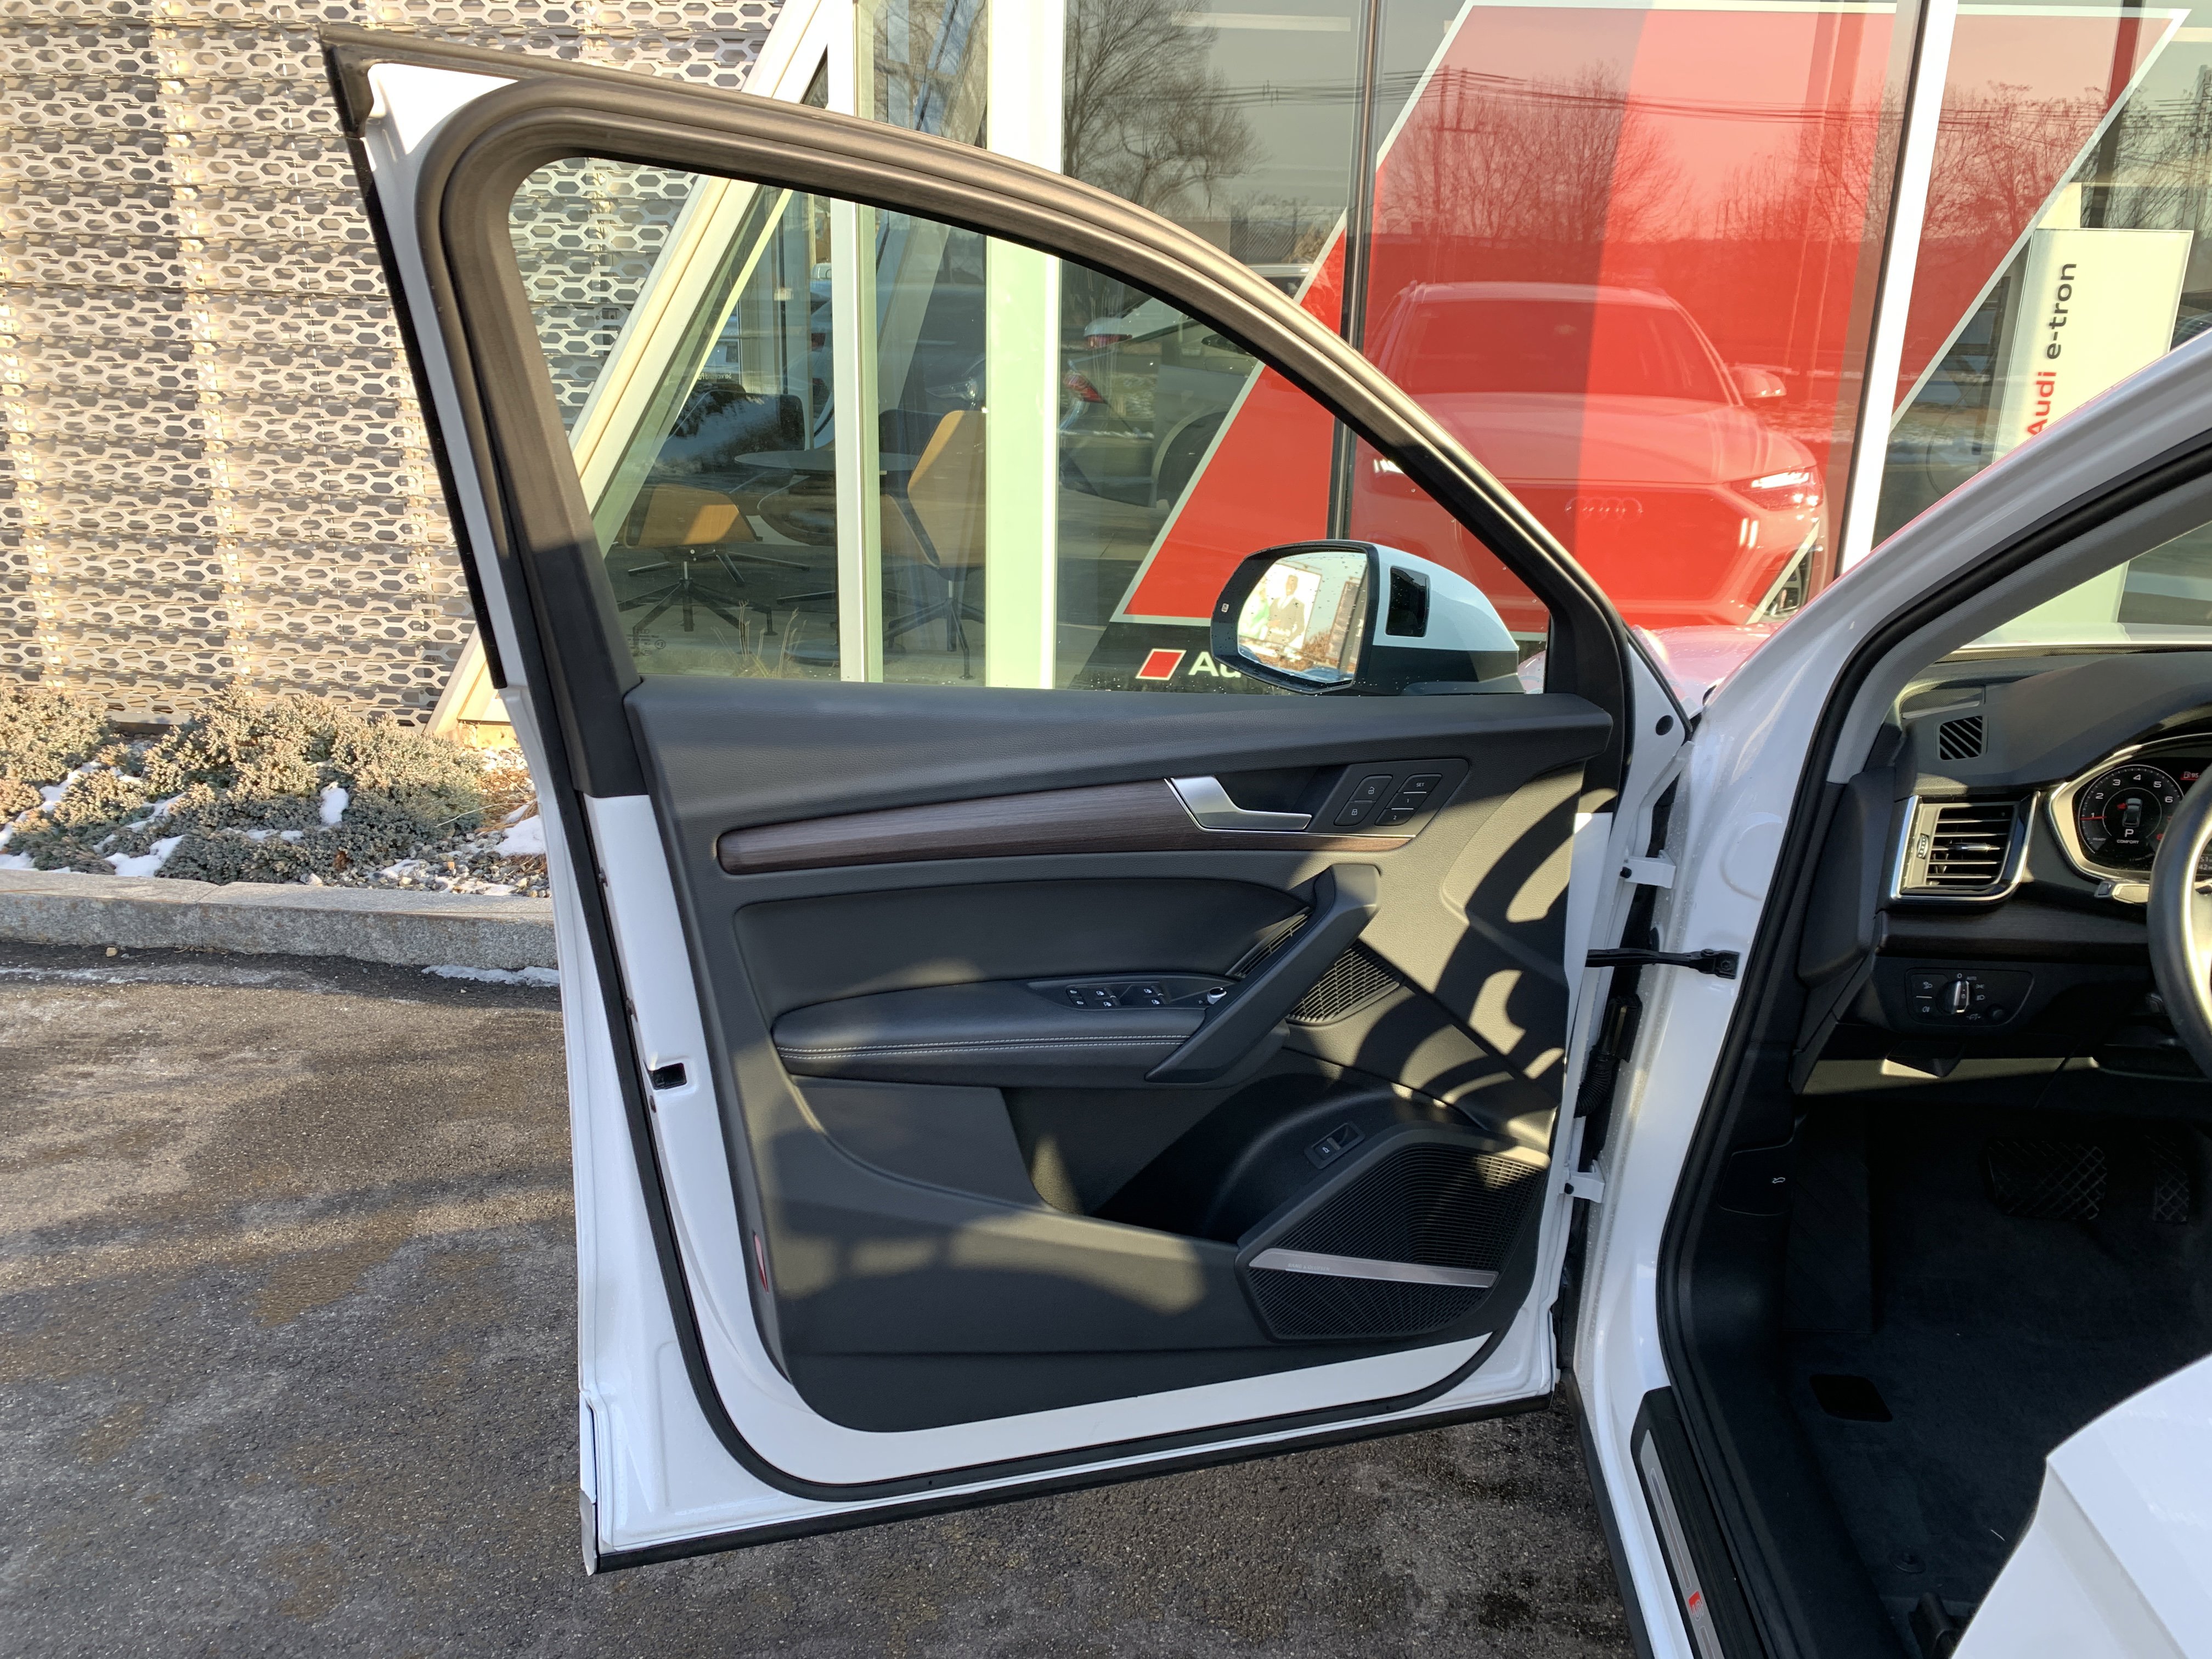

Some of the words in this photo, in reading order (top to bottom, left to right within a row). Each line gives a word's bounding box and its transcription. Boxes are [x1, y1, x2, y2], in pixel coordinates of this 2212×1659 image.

[2027, 371, 2057, 435] Audi
[2046, 263, 2077, 359] e-tron
[2124, 828, 2134, 838] P
